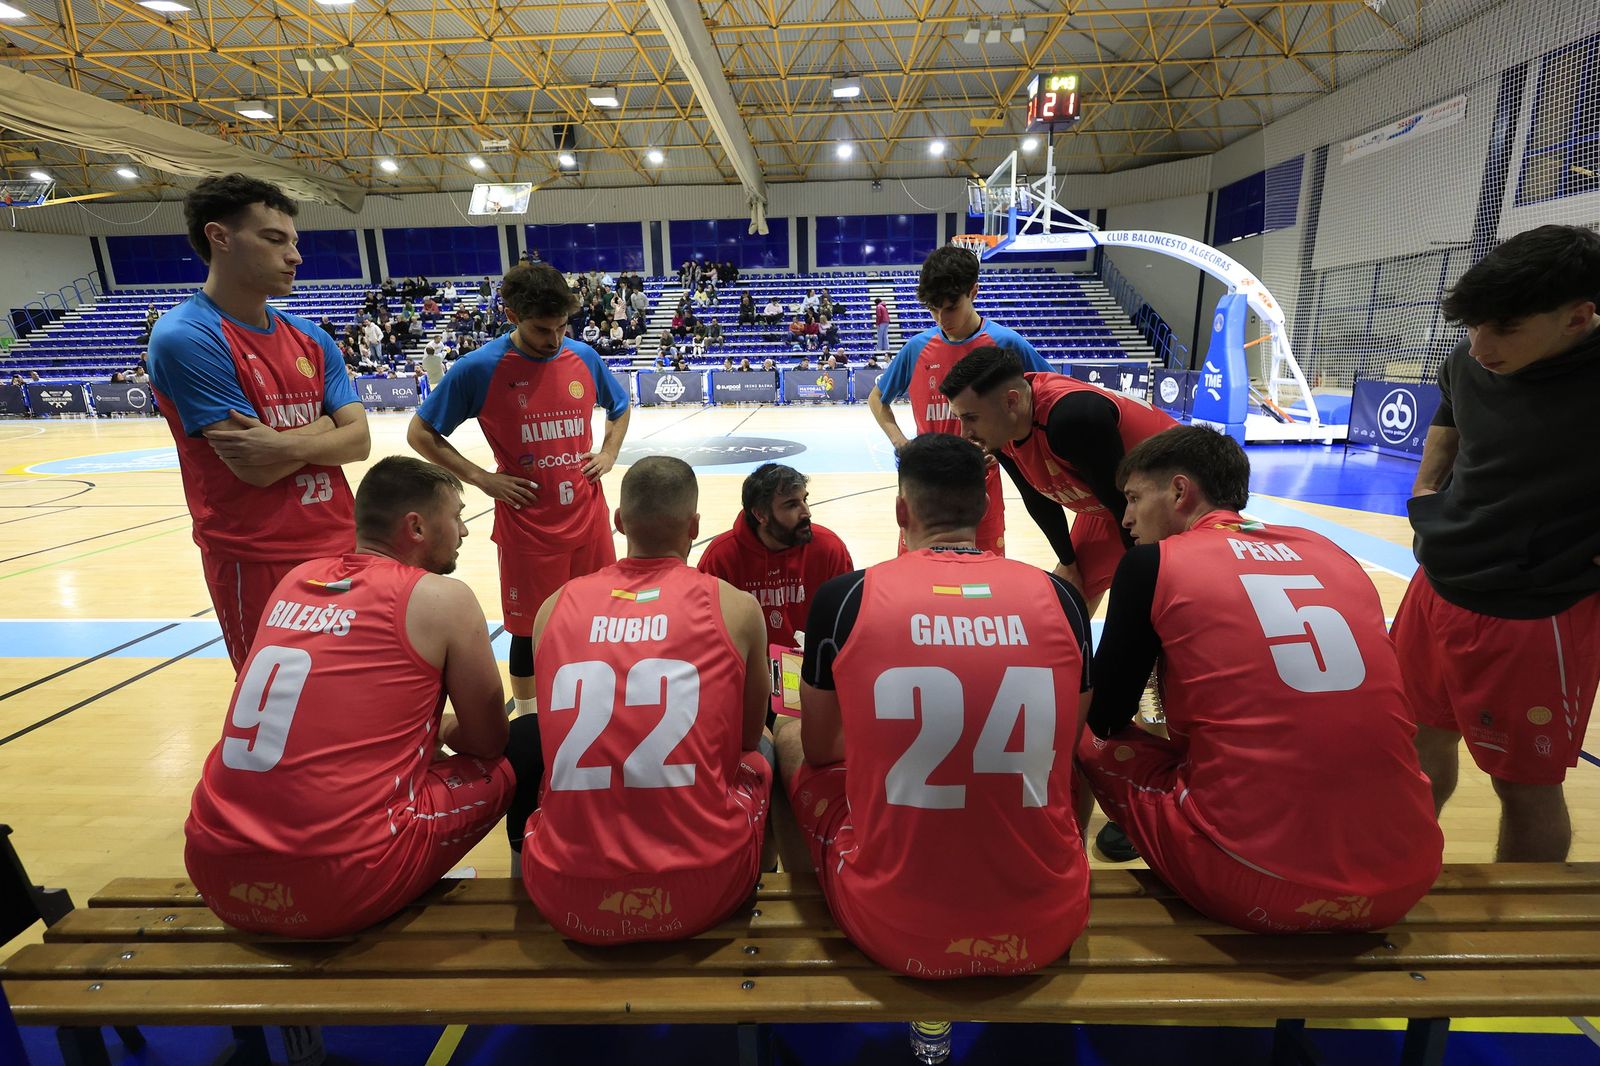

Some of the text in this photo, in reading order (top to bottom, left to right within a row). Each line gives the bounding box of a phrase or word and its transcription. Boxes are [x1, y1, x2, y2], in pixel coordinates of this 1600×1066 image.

[1106, 233, 1232, 271] CLUB BALONCESTO ALGECIRAS
[392, 388, 414, 396] ROA
[655, 385, 686, 394] 2000
[1205, 373, 1223, 388] TME
[521, 416, 584, 443] ALMERÍA
[295, 472, 333, 505] 23
[559, 480, 574, 505] 6
[1226, 538, 1303, 562] PEÑA
[266, 600, 357, 636] BILEIŠIS
[589, 614, 669, 643] RUBIO
[910, 613, 1029, 647] GARCIA
[1238, 573, 1366, 693] 5
[222, 645, 312, 773] 9
[550, 658, 700, 792] 22
[874, 666, 1057, 810] 24
